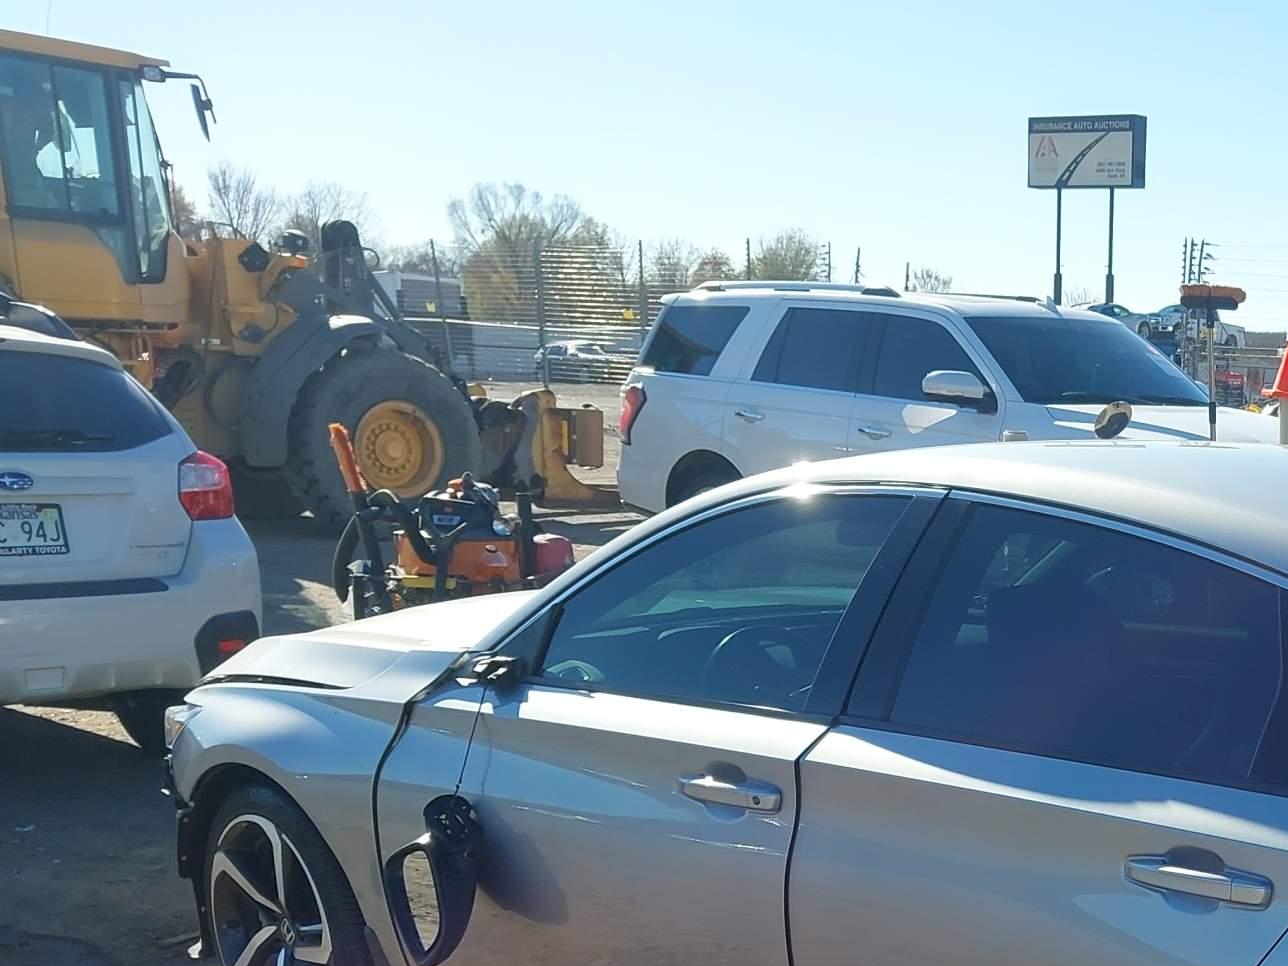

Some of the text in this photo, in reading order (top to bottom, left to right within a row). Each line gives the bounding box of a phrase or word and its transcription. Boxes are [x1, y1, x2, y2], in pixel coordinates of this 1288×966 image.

[1074, 121, 1093, 129] AUTO
[1094, 120, 1129, 129] AUCTIONS
[20, 519, 60, 543] 94J
